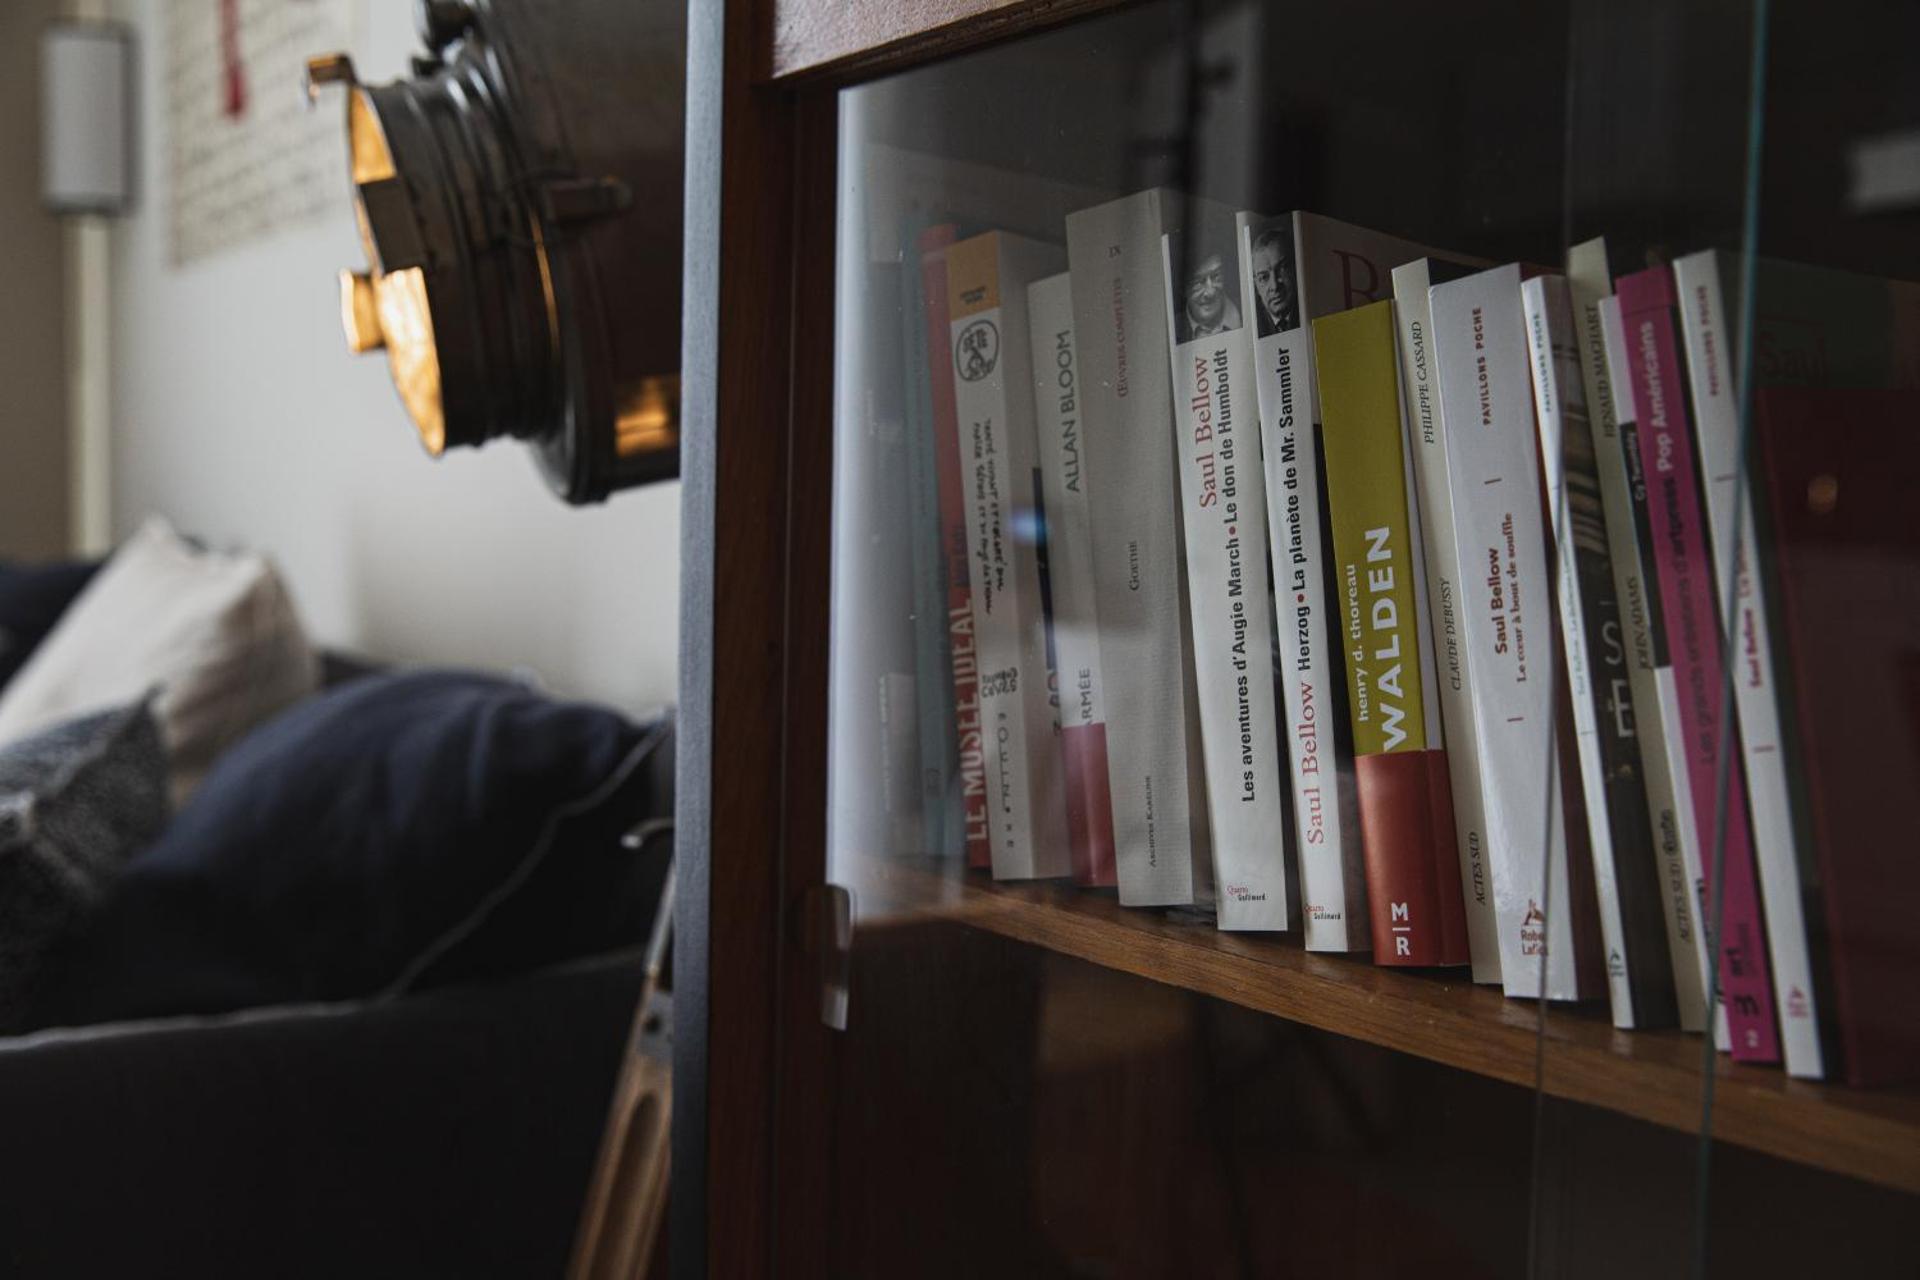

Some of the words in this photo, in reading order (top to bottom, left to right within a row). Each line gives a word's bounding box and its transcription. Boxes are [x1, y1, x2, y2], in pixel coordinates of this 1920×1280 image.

[1411, 321, 1427, 381] CASSARD
[1471, 306, 1483, 350] POCHE
[1533, 313, 1542, 349] POCHE
[1584, 304, 1606, 377] MACHART
[1056, 330, 1074, 414] BLOOM
[1213, 348, 1232, 433] Humboldt
[1277, 347, 1293, 431] Sammler
[1478, 356, 1492, 427] PAVILLONS
[1192, 357, 1212, 443] Bellow
[1418, 383, 1434, 445] PHILIPPE
[1065, 420, 1080, 493] ALLAN
[1219, 438, 1233, 460] de
[1282, 432, 1296, 464] Mr.
[1655, 433, 1673, 472] Pop
[1200, 453, 1217, 509] Saul
[1221, 465, 1236, 498] don
[1284, 466, 1297, 490] de
[1223, 503, 1237, 524] Le
[1288, 492, 1307, 562] planète
[1502, 513, 1515, 558] souffle
[1226, 538, 1242, 597] March
[1292, 568, 1306, 591] La
[1487, 547, 1504, 610] Bellow
[1507, 562, 1516, 578] de
[1347, 564, 1363, 639] thoreau
[1439, 576, 1455, 635] DEBUSSY
[1510, 582, 1520, 612] bout
[1230, 599, 1247, 671] d'Augie
[1297, 606, 1313, 672] Herzog
[1354, 645, 1365, 661] d.
[1364, 526, 1407, 750] WALDEN
[1492, 616, 1508, 654] Saul
[1514, 629, 1524, 661] cœur
[1634, 630, 1651, 670] JOHN
[1448, 637, 1461, 691] CLAUDE
[1516, 664, 1526, 683] Le
[1236, 676, 1253, 767] aventures
[1356, 682, 1371, 722] henry
[1300, 681, 1320, 776] Bellow
[1241, 772, 1255, 802] Les
[966, 806, 987, 842] LE
[1304, 785, 1324, 845] Saul
[1468, 831, 1480, 855] SUD
[1473, 857, 1487, 906] ACTES
[1391, 902, 1410, 922] M
[1396, 936, 1411, 956] R
